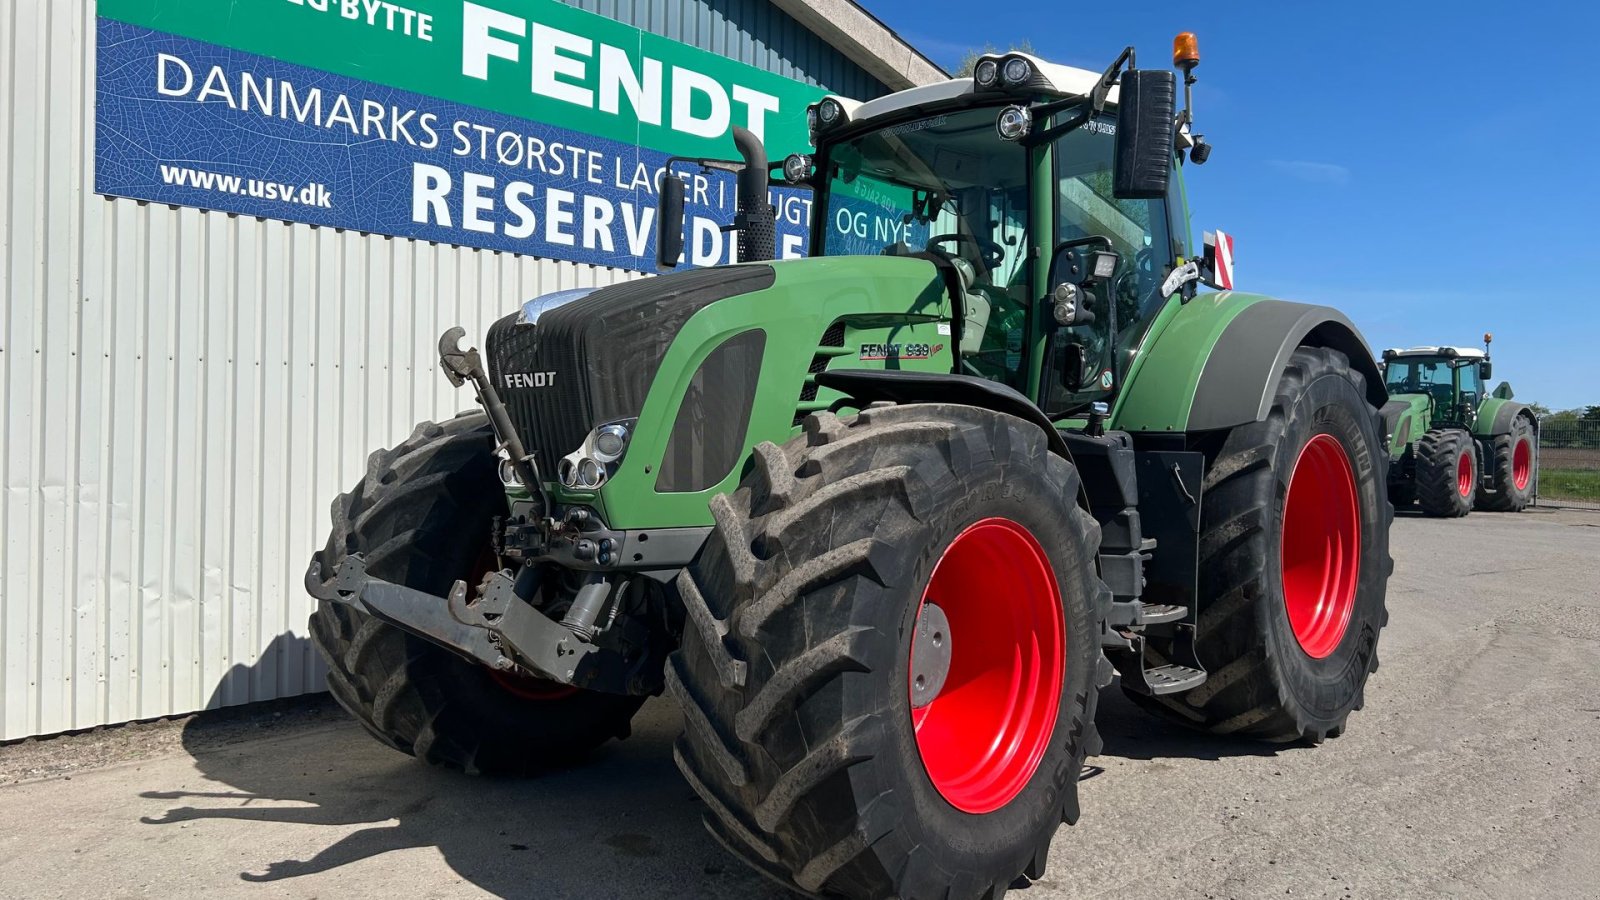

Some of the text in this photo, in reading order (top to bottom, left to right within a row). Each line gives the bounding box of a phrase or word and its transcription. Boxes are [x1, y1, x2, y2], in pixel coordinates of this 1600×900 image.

[462, 1, 780, 149] FENDT
[157, 53, 439, 149] DANMARKS
[453, 120, 603, 184] STØRSTE
[836, 207, 868, 238] OG
[874, 215, 913, 248] NYE
[160, 164, 332, 208] www.usv.dk
[860, 342, 902, 357] FENDT
[504, 371, 557, 389] FENDT
